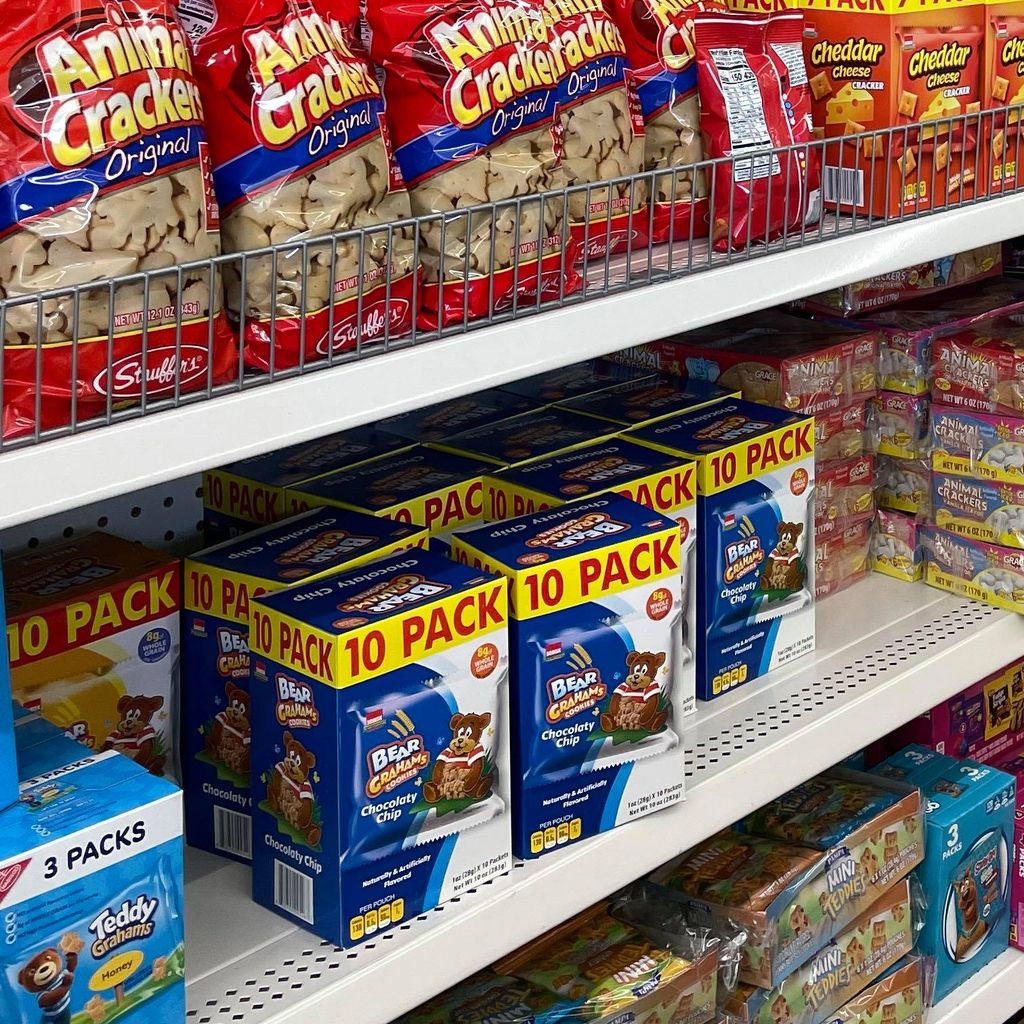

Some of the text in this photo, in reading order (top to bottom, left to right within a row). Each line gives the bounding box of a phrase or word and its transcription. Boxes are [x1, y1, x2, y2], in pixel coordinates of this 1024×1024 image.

[550, 13, 626, 73] rackers
[811, 38, 883, 63] Cheddar
[833, 67, 871, 78] Cheese
[909, 44, 970, 76] Cheddar
[568, 59, 617, 95] Original
[51, 70, 204, 166] Crackers
[258, 62, 379, 144] Crackers
[492, 91, 549, 135] Original
[309, 102, 371, 155] Original
[105, 128, 190, 180] Original
[114, 355, 199, 390] Stuffr's
[943, 394, 954, 402] NET
[954, 396, 963, 404] WT
[711, 423, 812, 488] 10 PACK
[938, 487, 987, 511] CRACKERS
[524, 534, 678, 611] 10 PACK
[720, 581, 757, 601] Chocolaty
[730, 593, 747, 605] Chip
[143, 640, 167, 651] WHOLE
[345, 585, 506, 677] 10 PACK
[144, 646, 166, 657] GRAIN
[551, 671, 597, 700] BEAR
[549, 686, 604, 720] GRAHAMS
[542, 720, 595, 741] Chocolaty
[556, 735, 580, 748] Chip
[371, 738, 420, 771] BEAR
[369, 753, 429, 793] GRAHAMS
[385, 769, 417, 791] COOKIES
[664, 783, 683, 795] Packets
[361, 792, 417, 818] Chocolaty
[376, 809, 402, 824] Chip
[630, 808, 639, 816] Net
[640, 805, 649, 813] Wt
[44, 821, 146, 879] 3 PACKS
[947, 824, 959, 847] 3
[363, 872, 392, 887] Naturally
[399, 855, 431, 872] Artificially
[384, 872, 411, 888] Flavored
[828, 860, 855, 892] MINI
[359, 894, 395, 913] PER POUCH
[824, 875, 865, 918] TEDDIES
[90, 896, 159, 940] Teddy
[93, 921, 153, 957] Grahams
[102, 960, 133, 981] Honey
